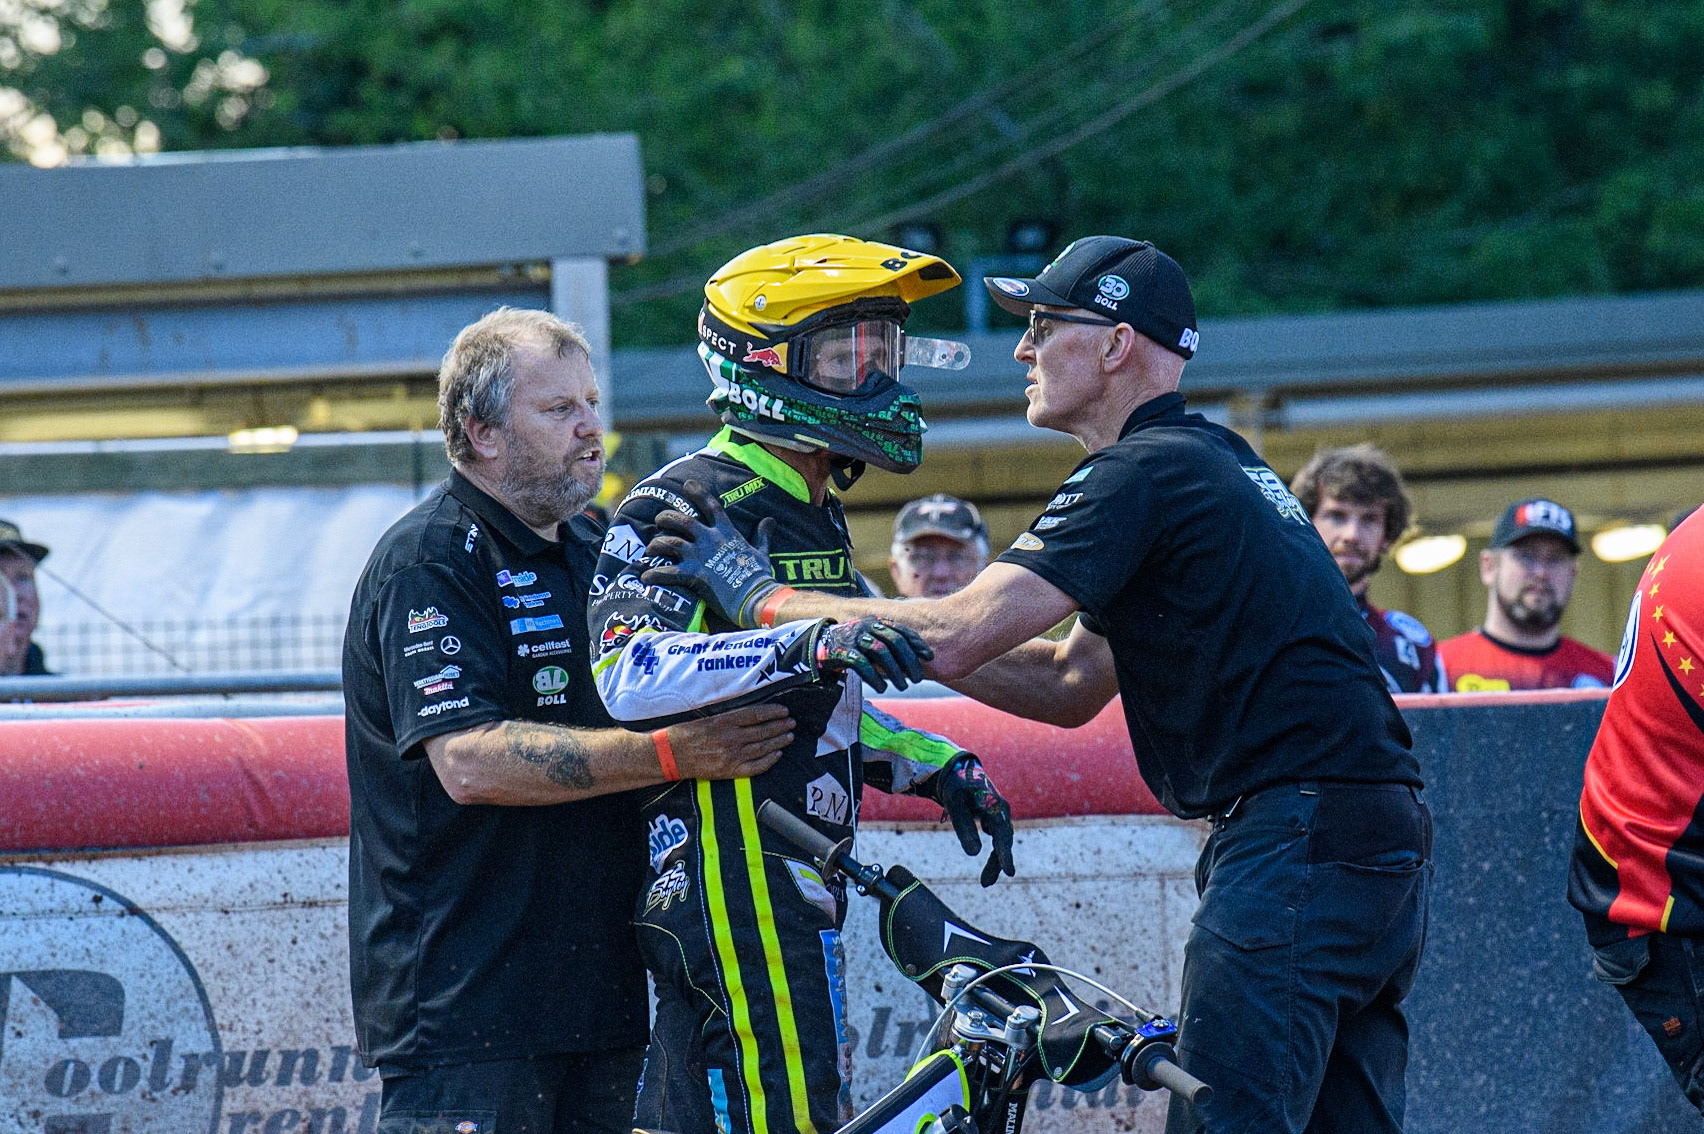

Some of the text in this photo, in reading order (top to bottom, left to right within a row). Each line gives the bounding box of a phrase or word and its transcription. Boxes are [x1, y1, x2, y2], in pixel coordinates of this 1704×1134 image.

[1095, 294, 1118, 311] BOLL
[728, 382, 785, 421] BOLL
[725, 479, 766, 504] TRU MIX
[779, 557, 845, 581] TRU
[531, 640, 571, 652] cellfast
[667, 643, 710, 655] Grant
[537, 694, 567, 706] BOLL
